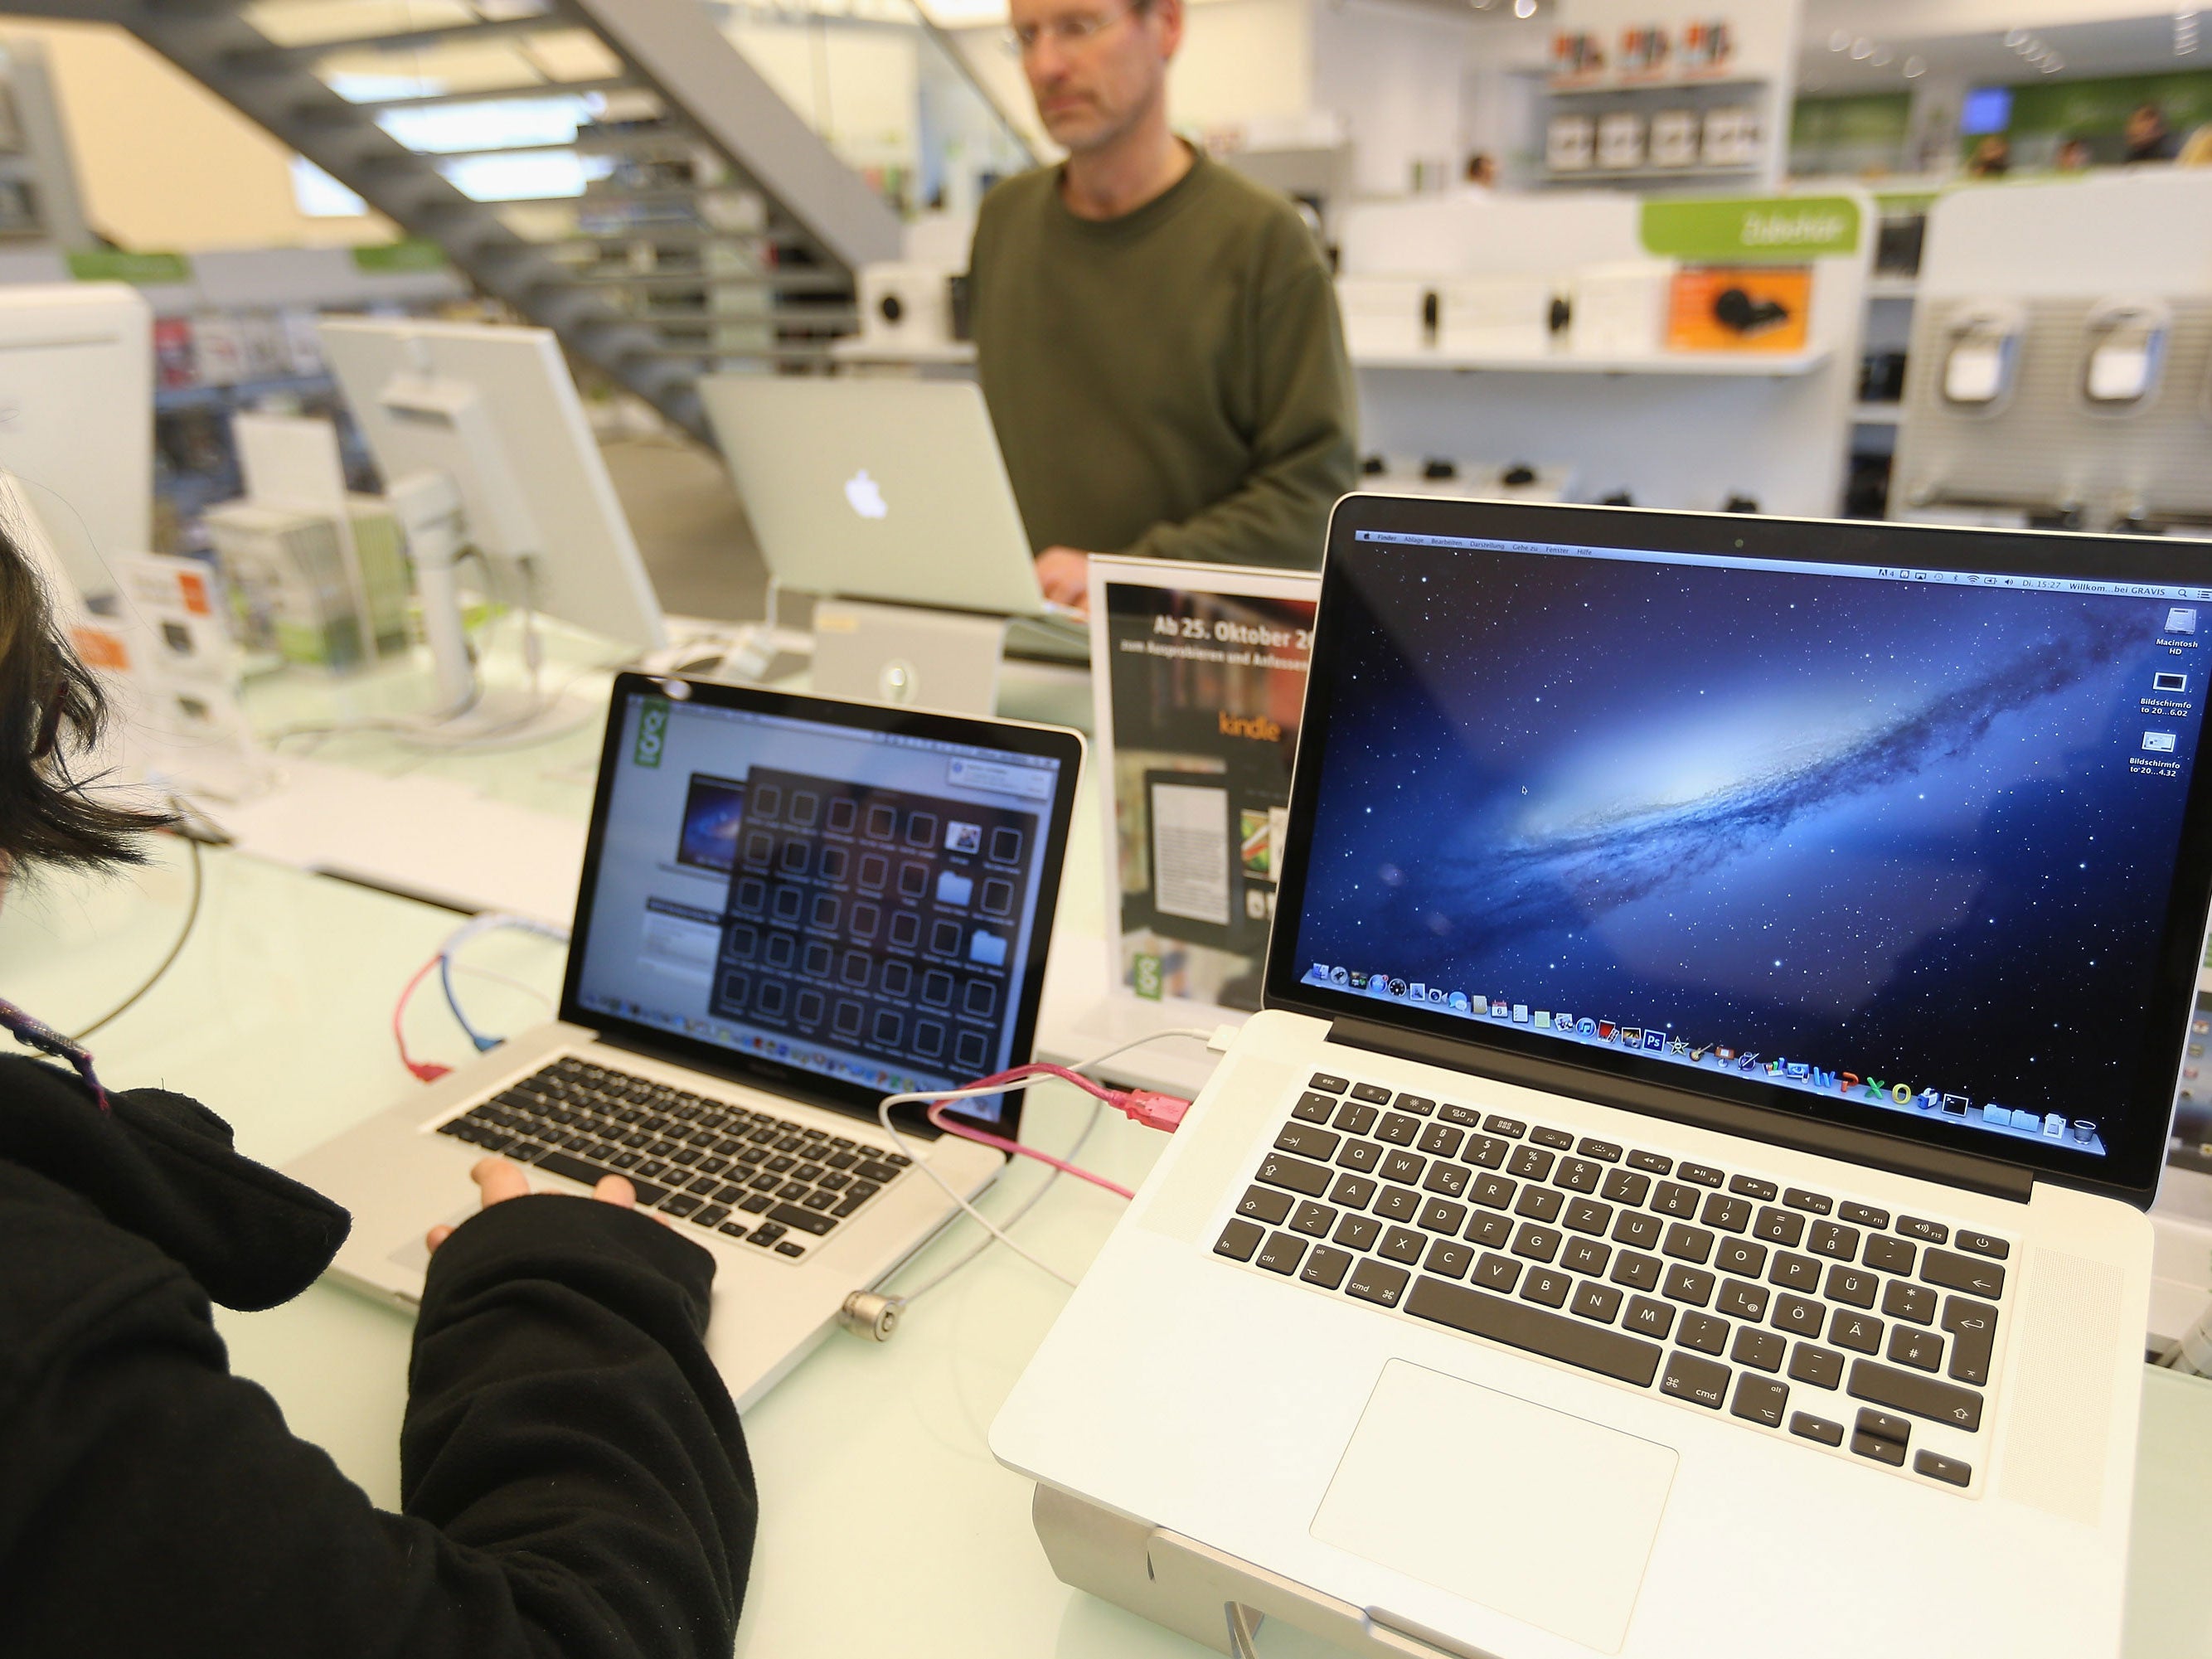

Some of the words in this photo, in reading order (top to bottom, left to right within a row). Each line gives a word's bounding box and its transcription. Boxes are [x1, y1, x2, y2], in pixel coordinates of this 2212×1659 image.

[1470, 541, 1505, 550] Darstellung
[2038, 580, 2060, 589] 15:27
[2132, 587, 2166, 596] GRAVIS
[1153, 615, 1179, 636] Ab
[1183, 618, 1210, 640] 25.
[1214, 621, 1291, 647] Oktober
[2156, 638, 2198, 648] Macintosh
[2141, 698, 2191, 708] Bildschirmfo
[1219, 710, 1280, 741] kindle
[2130, 758, 2180, 769] Bildschirmfo
[1647, 1037, 1660, 1046] Ps
[1433, 1140, 1442, 1148] 3
[1483, 1140, 1492, 1149] $
[1354, 1150, 1365, 1159] Q
[1478, 1152, 1487, 1160] 4
[1528, 1152, 1537, 1161] %
[1396, 1161, 1410, 1171] W
[1524, 1163, 1533, 1171] 5
[1575, 1164, 1584, 1172] &
[1443, 1173, 1451, 1182] E
[1572, 1175, 1579, 1183] 6
[1346, 1186, 1356, 1195] A
[1487, 1185, 1496, 1195] R
[1619, 1187, 1627, 1196] 7
[1392, 1198, 1401, 1207] S
[1535, 1196, 1544, 1206] T
[1669, 1200, 1676, 1209] 8
[1436, 1210, 1447, 1220] D
[1582, 1210, 1594, 1220] Z
[1721, 1212, 1729, 1221] 9
[1353, 1225, 1362, 1235] Y
[1484, 1223, 1493, 1232] F
[1632, 1222, 1643, 1234] U
[1832, 1228, 1839, 1237] ?
[1396, 1239, 1408, 1249] X
[1530, 1236, 1542, 1246] G
[1443, 1253, 1454, 1263] C
[1579, 1249, 1592, 1260] H
[1492, 1265, 1502, 1276] V
[1632, 1264, 1640, 1274] J
[1791, 1264, 1800, 1275] P
[1351, 1282, 1370, 1293] cmd
[1541, 1280, 1550, 1290] B
[1683, 1278, 1694, 1290] K
[1846, 1277, 1857, 1290] Ü
[1590, 1294, 1603, 1306] N
[1739, 1293, 1745, 1303] L
[1641, 1309, 1655, 1322] M
[1792, 1306, 1804, 1319] Ö
[1850, 1322, 1860, 1336] Ä
[1909, 1348, 1919, 1358] #
[1695, 1388, 1717, 1400] cmd
